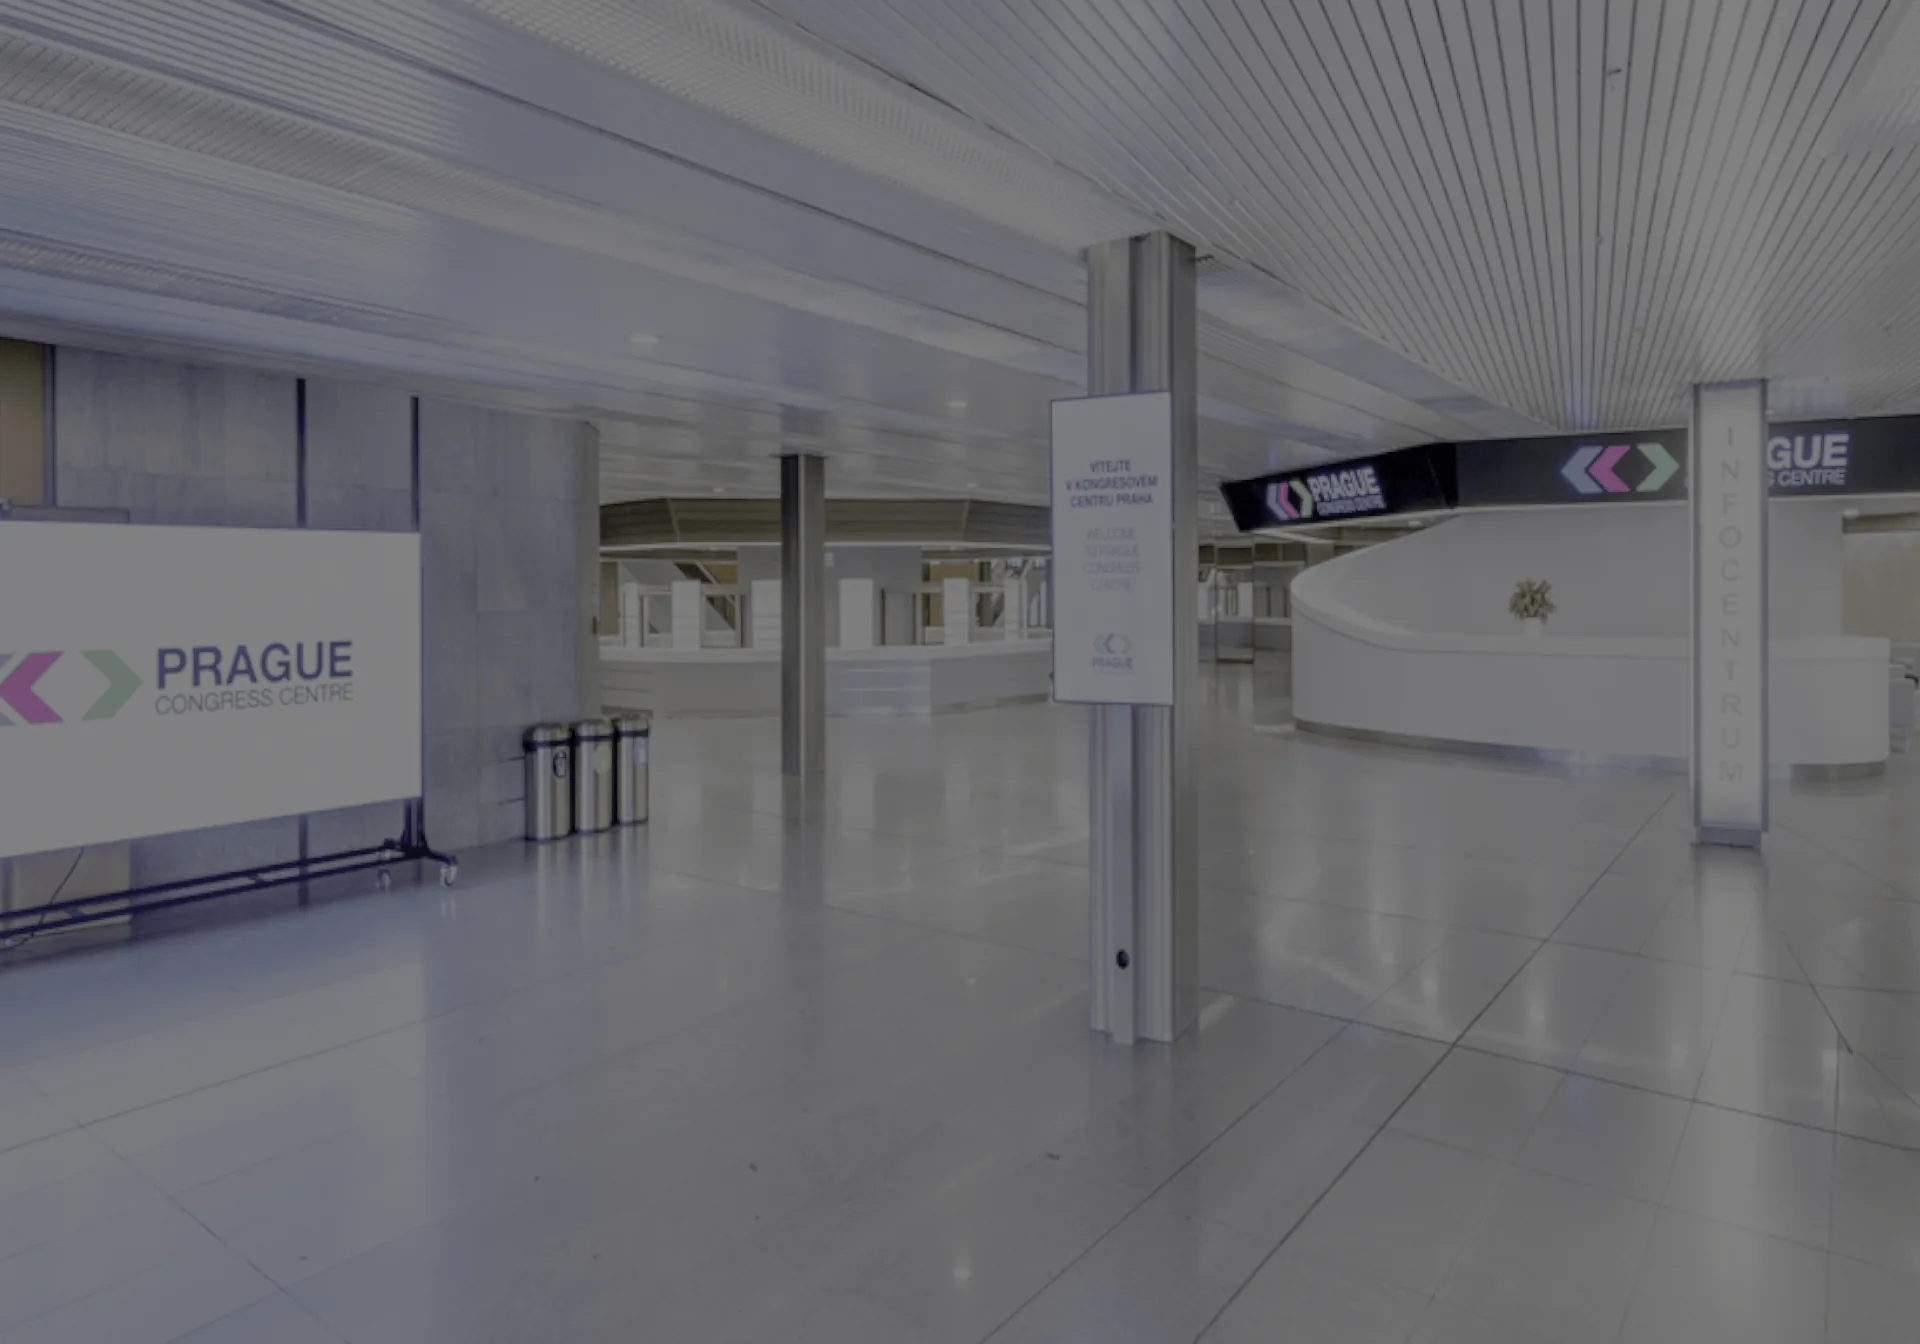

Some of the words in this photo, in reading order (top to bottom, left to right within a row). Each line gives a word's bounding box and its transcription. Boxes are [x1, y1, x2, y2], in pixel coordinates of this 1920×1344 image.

[1767, 433, 1850, 470] GUE
[1307, 465, 1381, 502] PRAGUE
[1778, 467, 1847, 487] CENTRE
[1070, 494, 1113, 507] CENTRU
[1116, 492, 1154, 505] PRAHA
[1086, 527, 1135, 540] WELCOME
[1718, 426, 1743, 783] INFOCENTRUM
[155, 640, 354, 690] PRAGUE
[154, 687, 275, 716] CONGRESS
[278, 682, 354, 706] CENTRE
